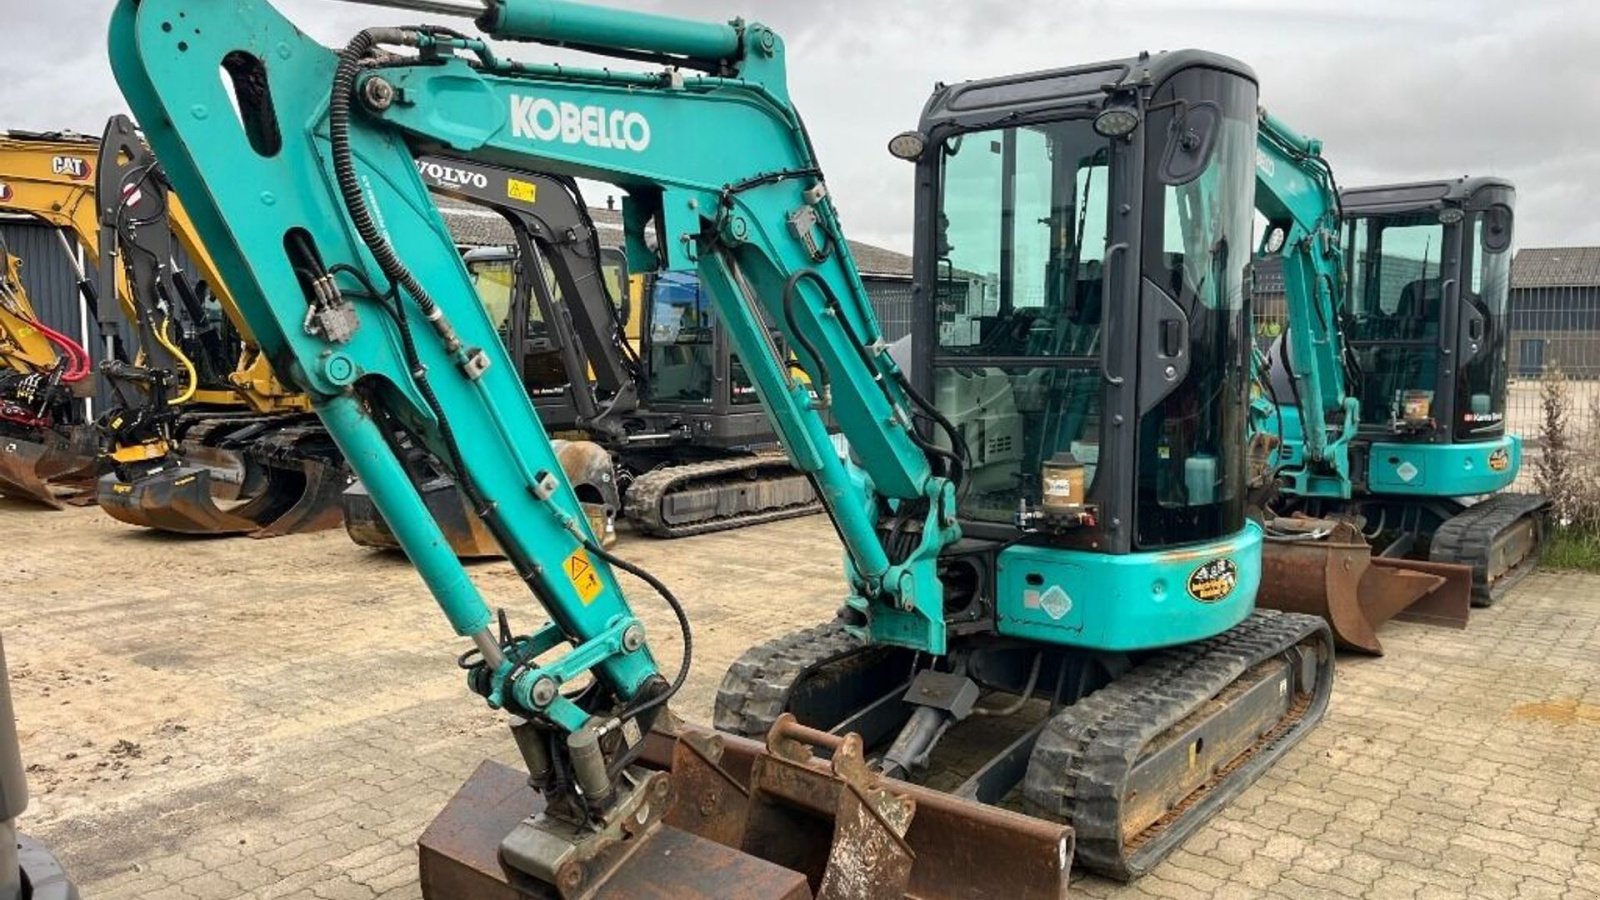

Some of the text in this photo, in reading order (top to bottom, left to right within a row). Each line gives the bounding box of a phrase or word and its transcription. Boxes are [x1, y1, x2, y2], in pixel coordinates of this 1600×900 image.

[510, 94, 651, 152] KOBELCO
[52, 156, 82, 176] CAT
[413, 159, 488, 189] VOLVO
